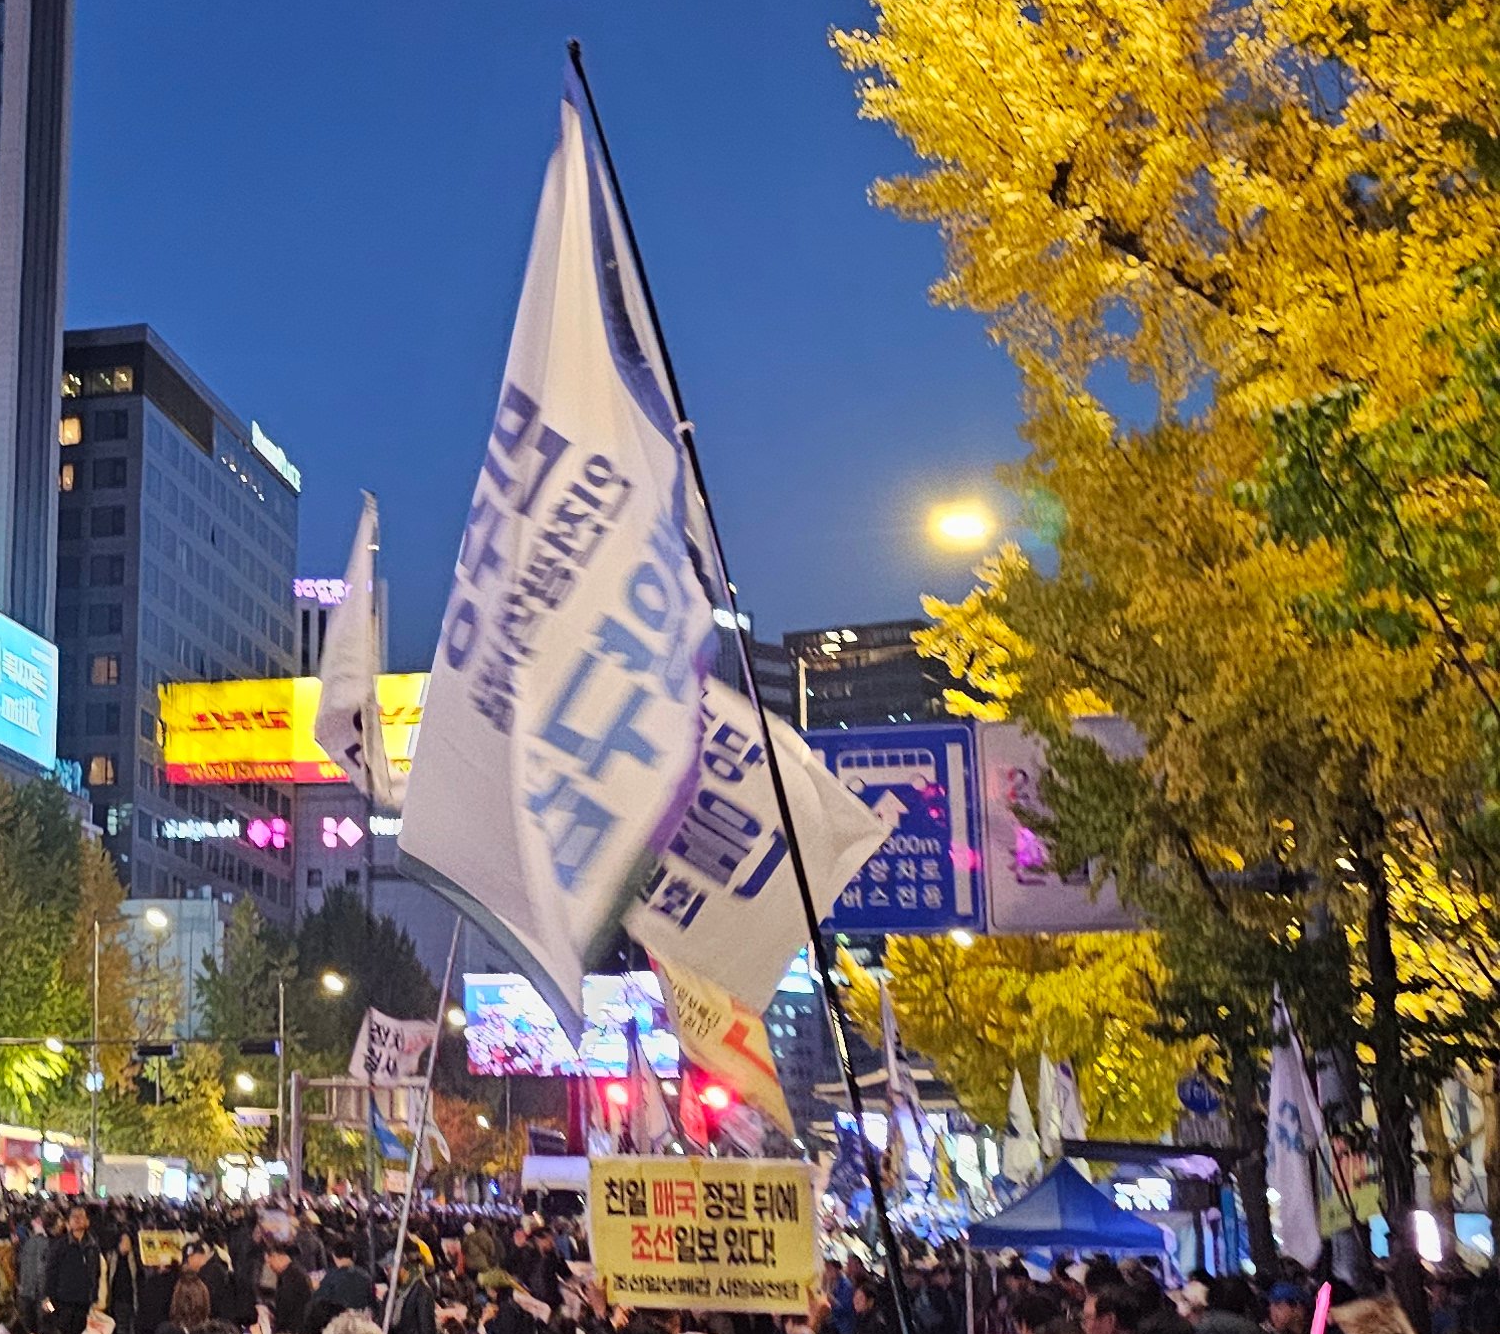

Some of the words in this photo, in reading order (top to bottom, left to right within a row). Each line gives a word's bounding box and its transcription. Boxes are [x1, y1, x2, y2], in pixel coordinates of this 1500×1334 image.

[852, 857, 943, 883] 앙차로
[604, 1177, 648, 1217] 친일
[652, 1178, 697, 1220] 매국
[702, 1180, 748, 1221] 정권
[753, 1181, 799, 1223] 뒤에
[631, 1223, 719, 1266] 조선일보
